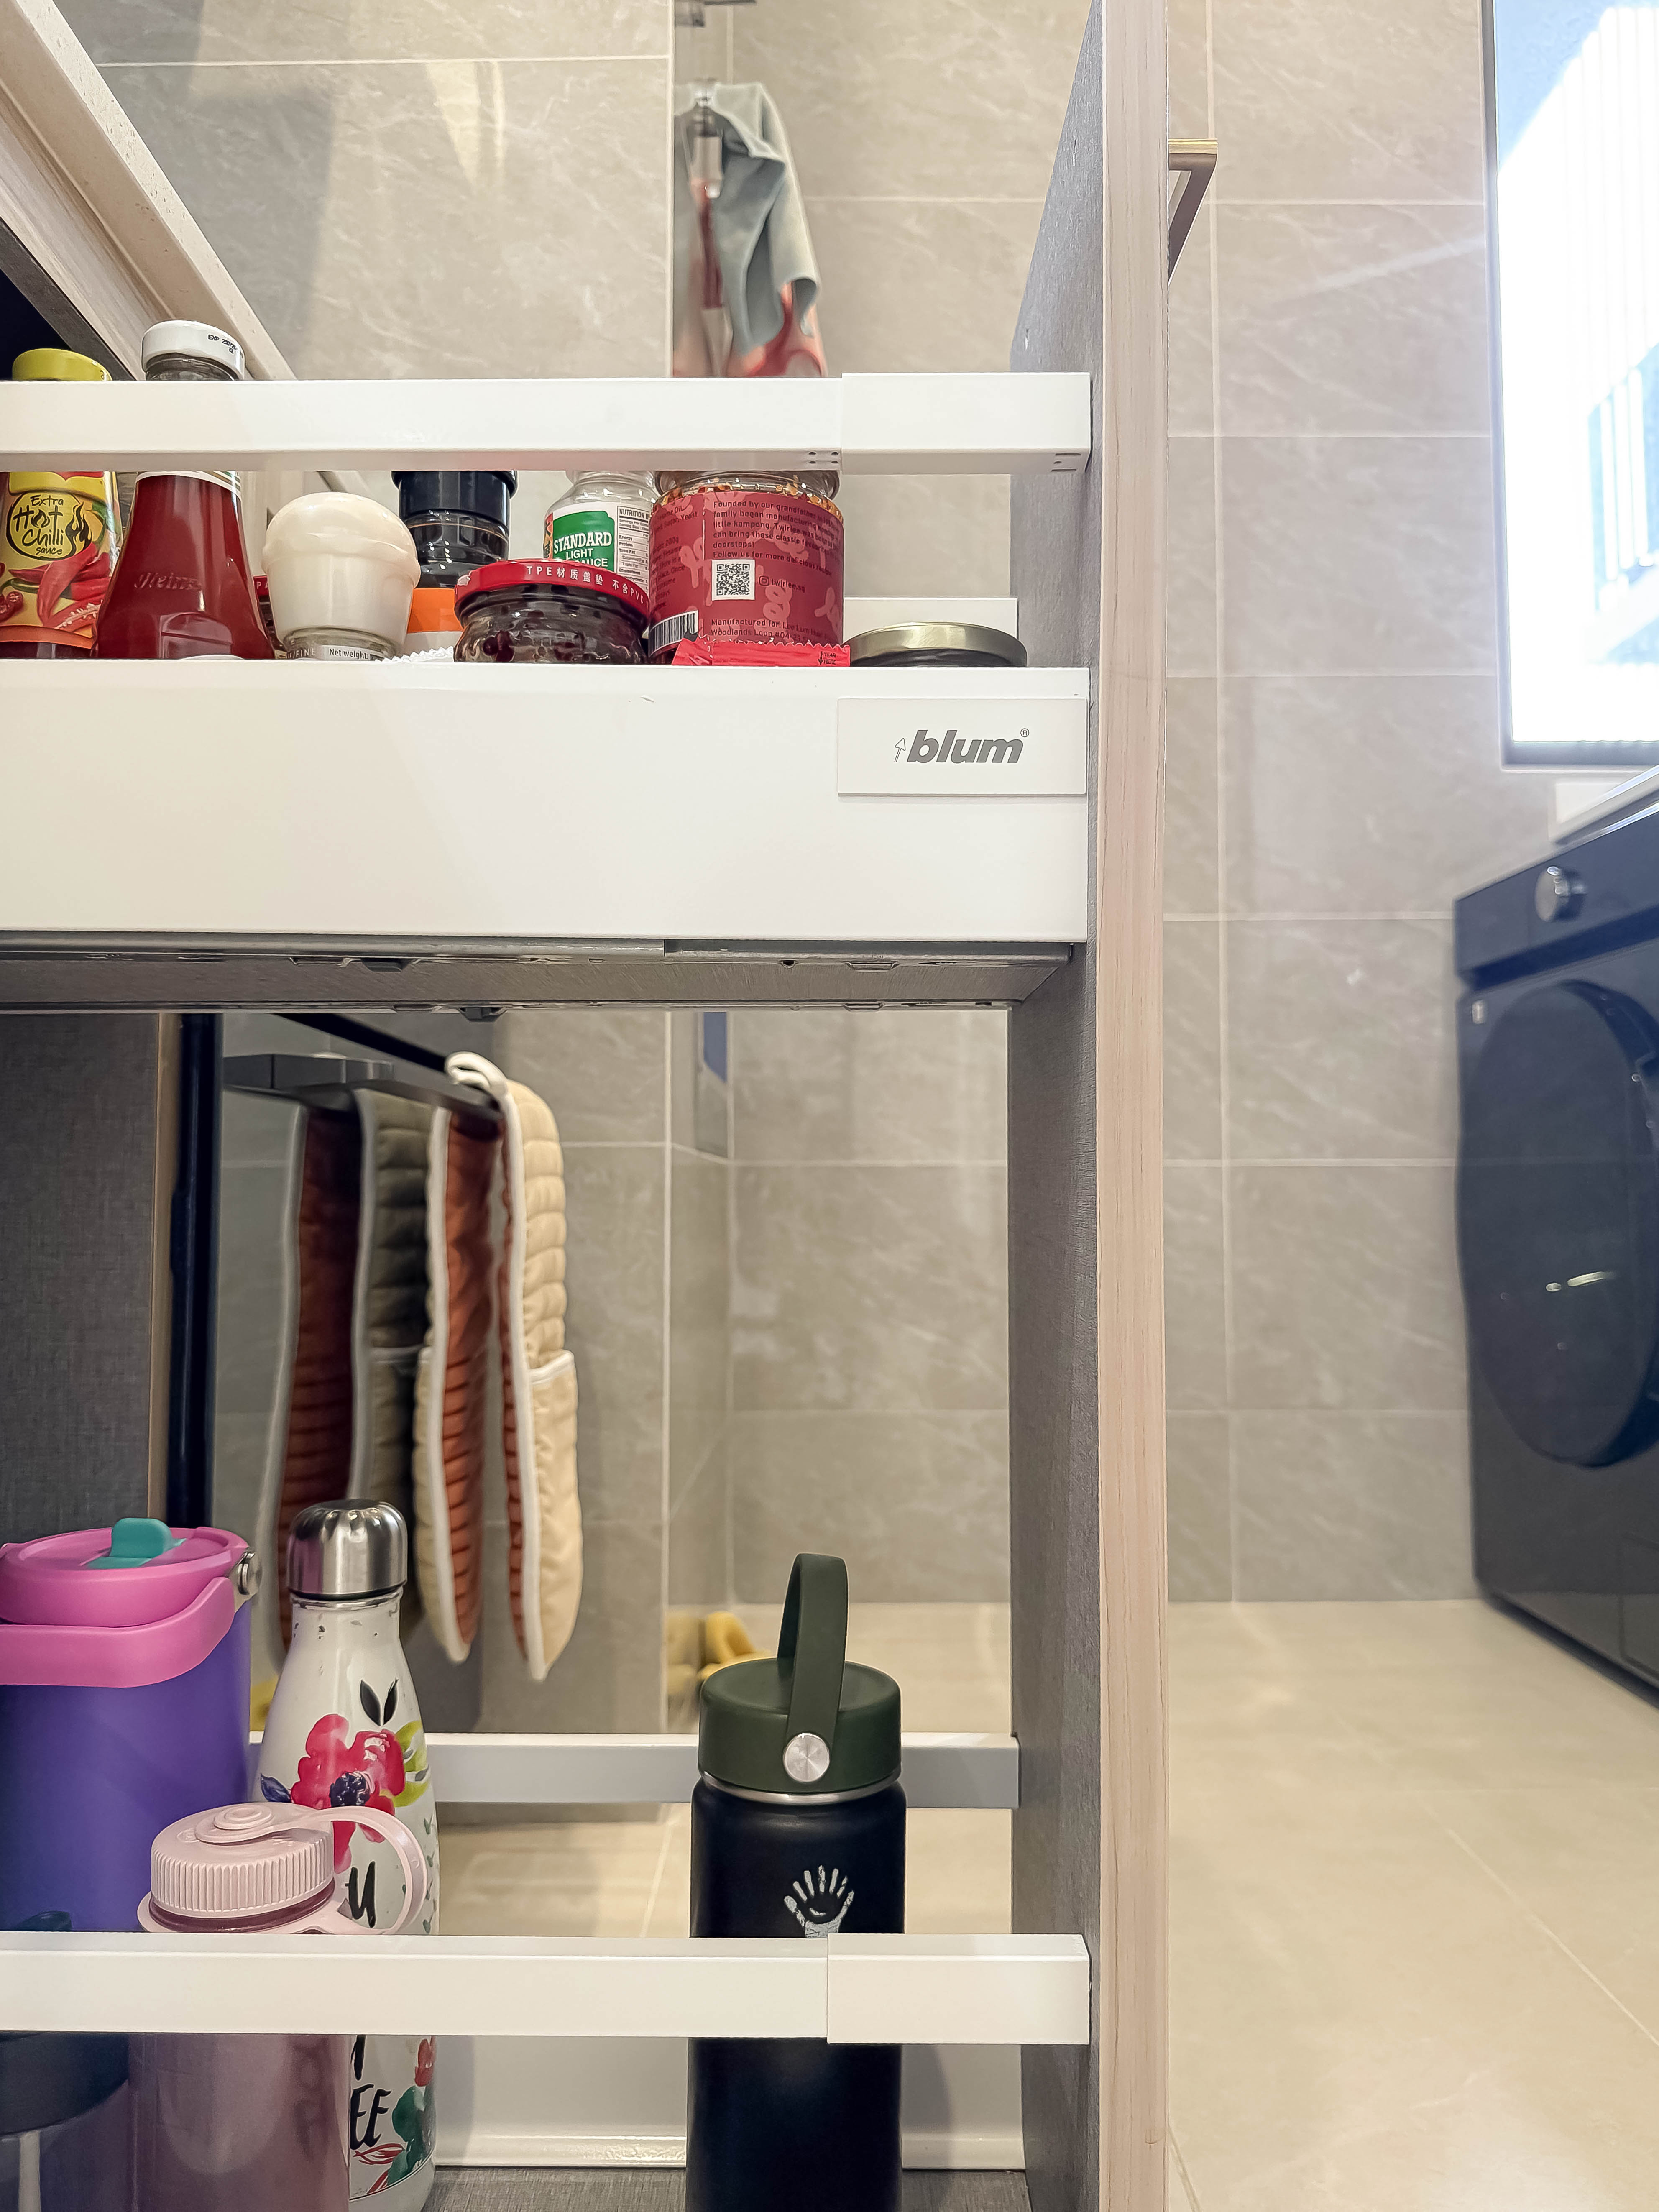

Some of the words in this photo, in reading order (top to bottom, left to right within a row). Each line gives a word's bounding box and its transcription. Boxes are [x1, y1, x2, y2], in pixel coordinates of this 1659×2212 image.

[30, 495, 64, 506] Extra
[619, 509, 644, 519] NUTRITION
[774, 522, 800, 534] Twirlee
[22, 528, 64, 547] Chilli
[554, 532, 612, 554] STANDARD
[752, 531, 774, 539] these
[776, 531, 800, 544] classic
[36, 546, 62, 555] sauce
[566, 548, 593, 560] LIGHT
